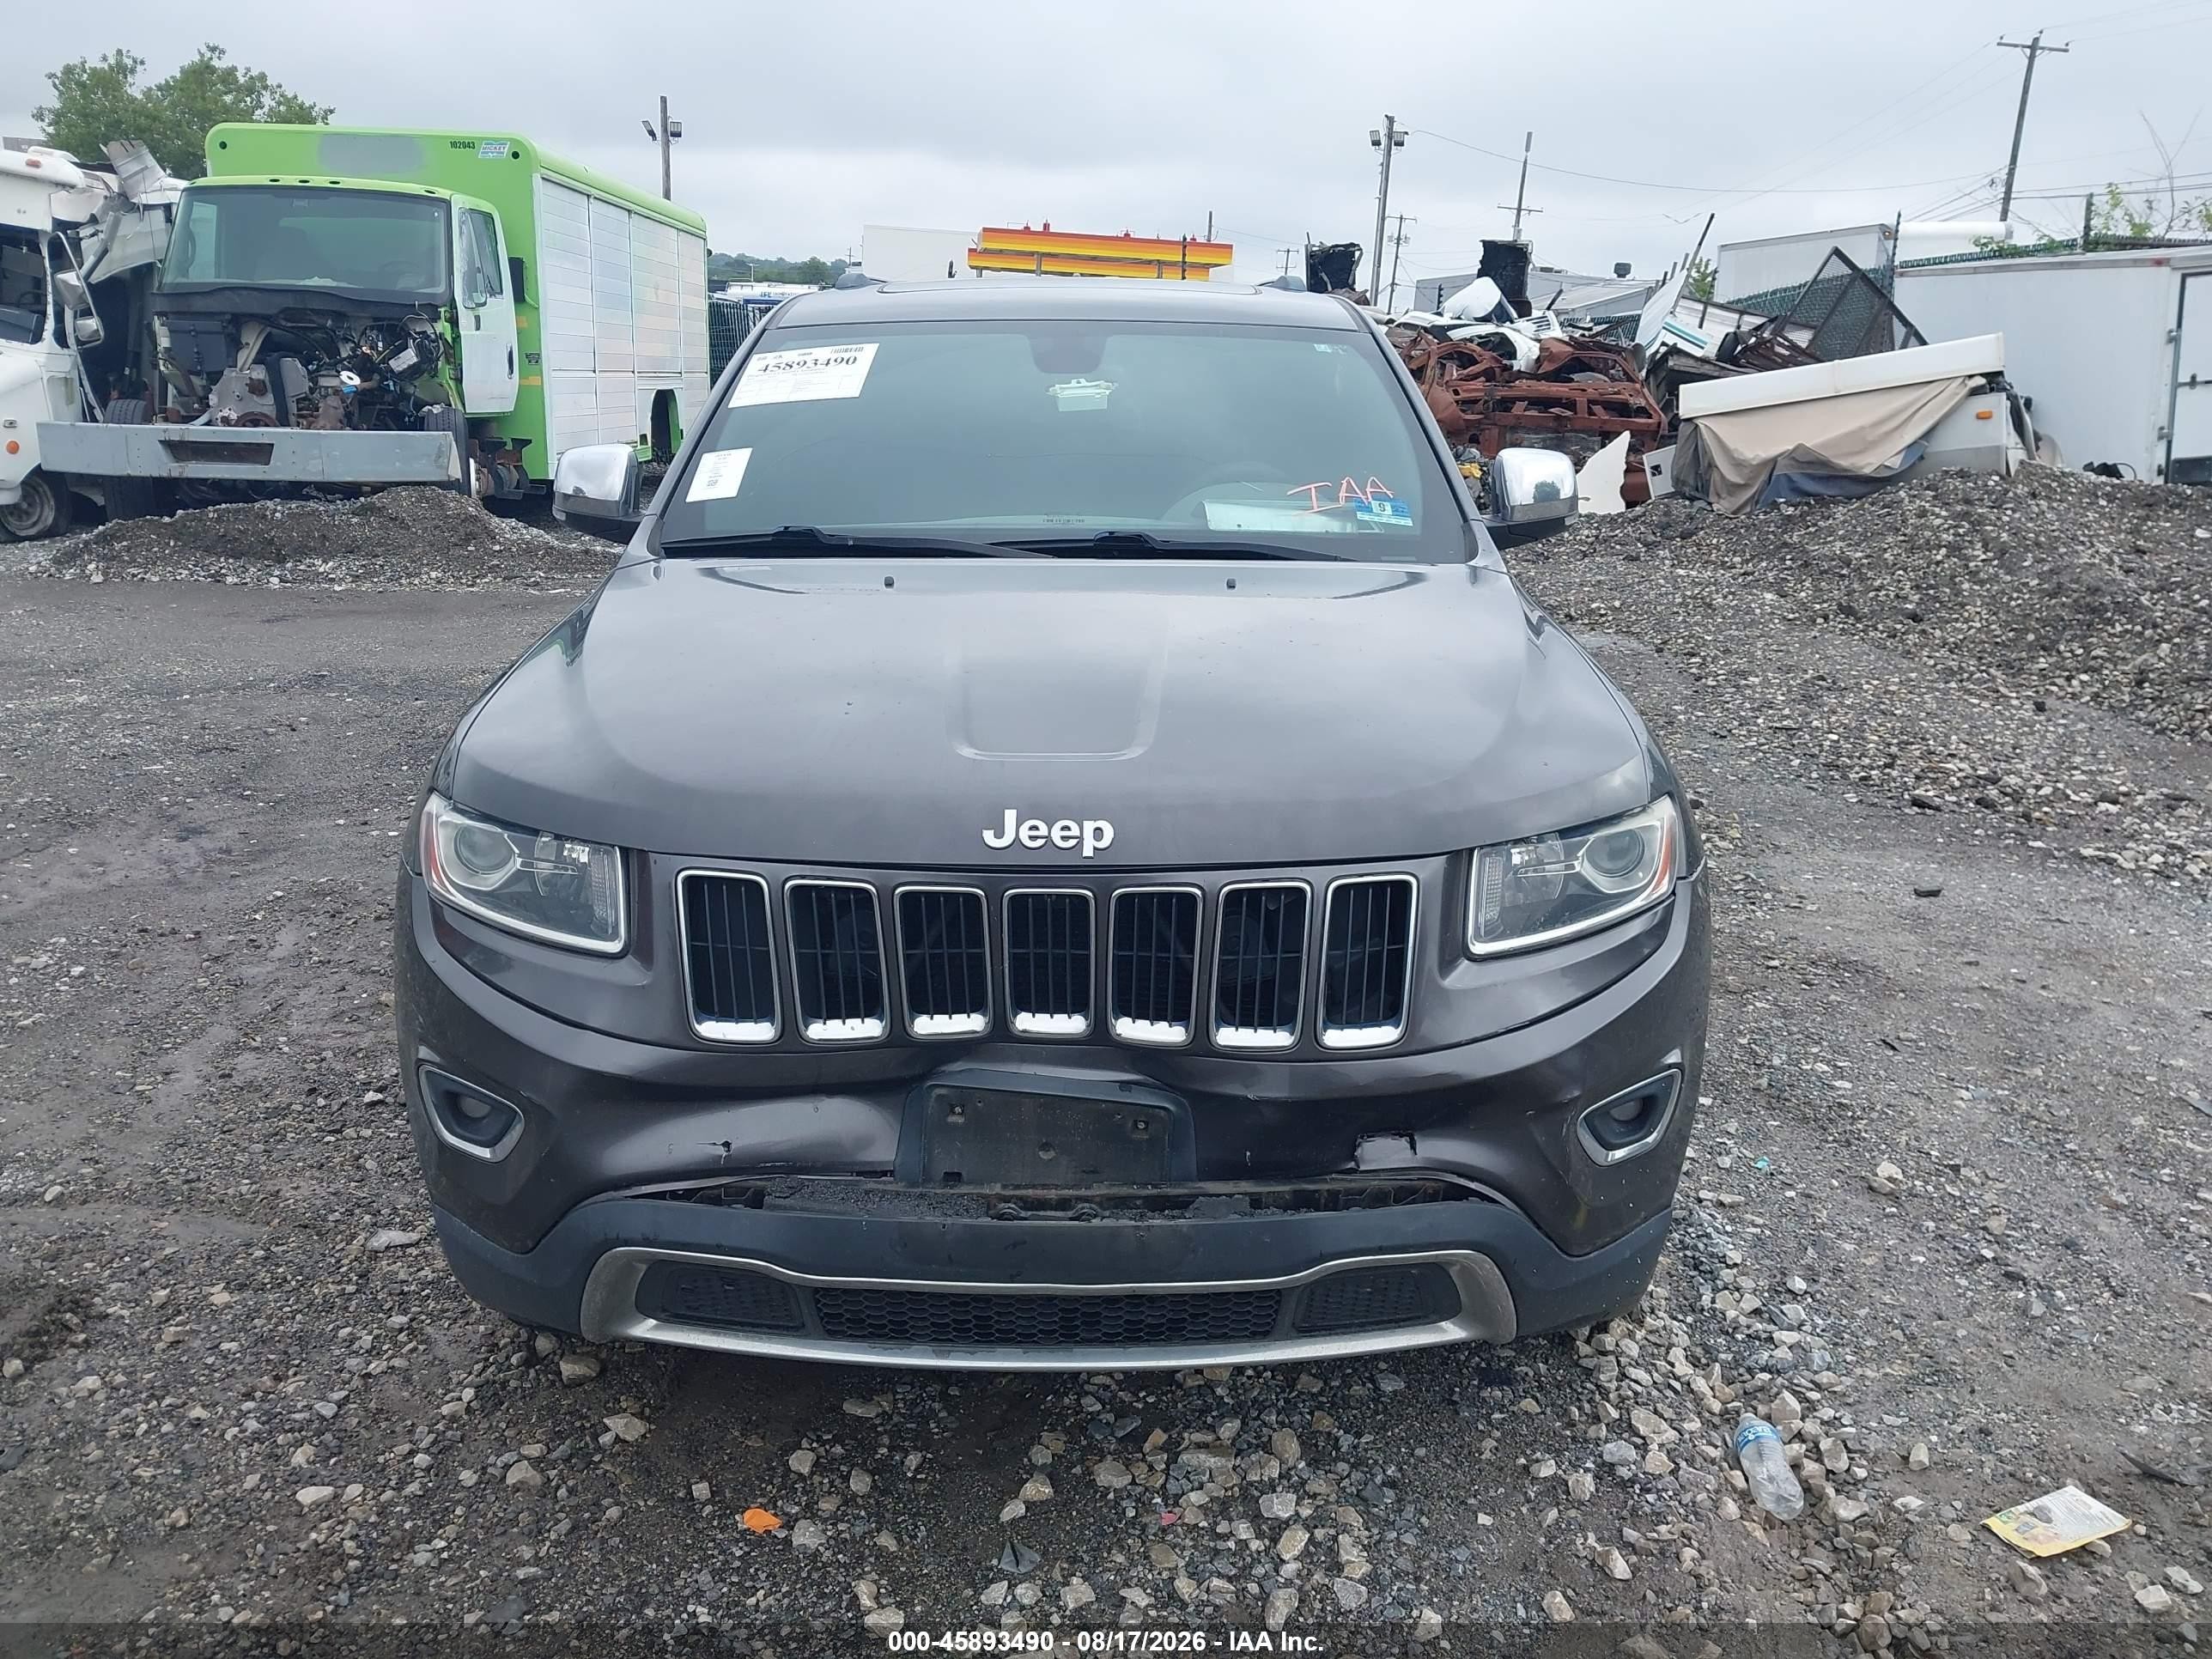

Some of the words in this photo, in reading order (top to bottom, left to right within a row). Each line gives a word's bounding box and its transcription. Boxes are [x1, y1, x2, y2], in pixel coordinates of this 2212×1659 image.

[449, 141, 476, 149] 102043
[757, 355, 858, 374] 45893490
[1286, 477, 1395, 515] IAA
[1378, 502, 1387, 514] 9
[981, 809, 1115, 859] Jeep
